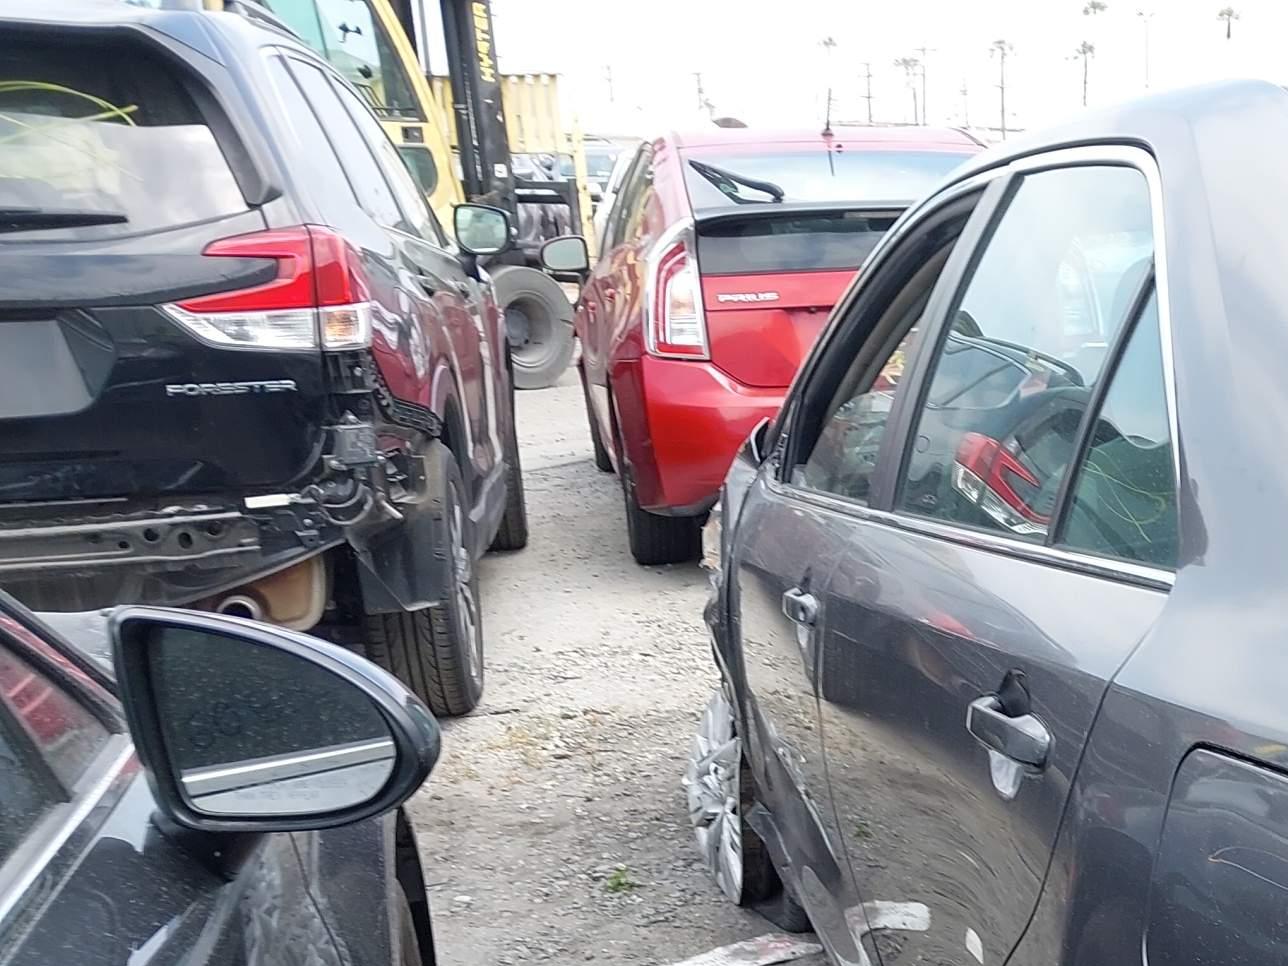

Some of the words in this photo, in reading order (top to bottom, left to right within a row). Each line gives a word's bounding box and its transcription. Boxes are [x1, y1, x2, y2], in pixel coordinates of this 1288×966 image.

[471, 2, 496, 82] HYSTER
[716, 292, 780, 303] PRIUS
[165, 379, 298, 397] FORESTER
